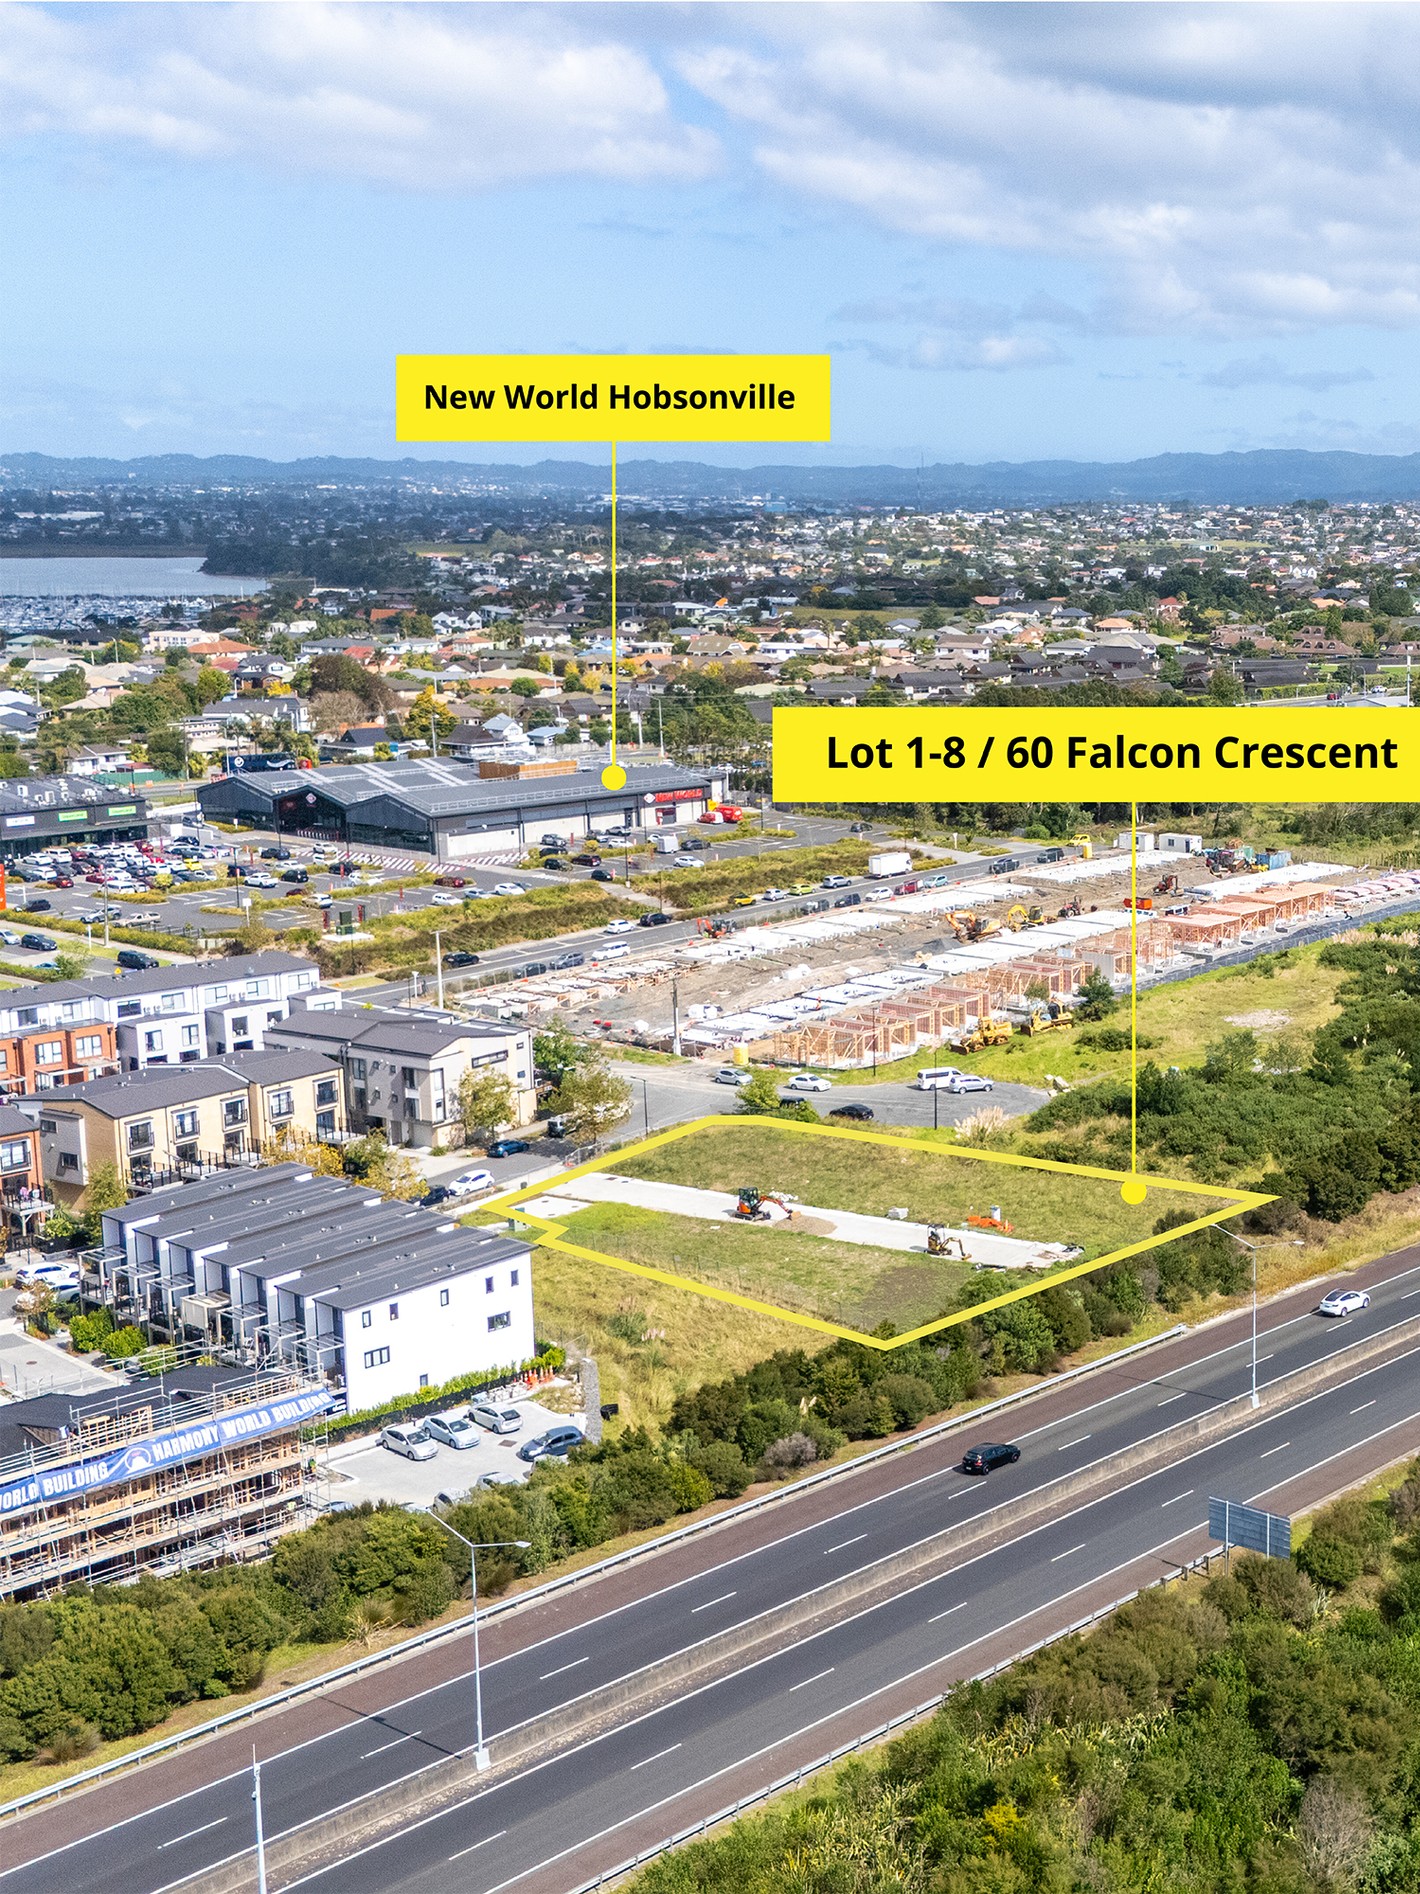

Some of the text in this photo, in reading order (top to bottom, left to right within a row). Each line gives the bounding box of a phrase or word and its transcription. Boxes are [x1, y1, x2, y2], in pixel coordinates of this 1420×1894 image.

[151, 1392, 332, 1462] HARMONY WORLD BUILDING
[42, 1461, 110, 1497] BUILDING
